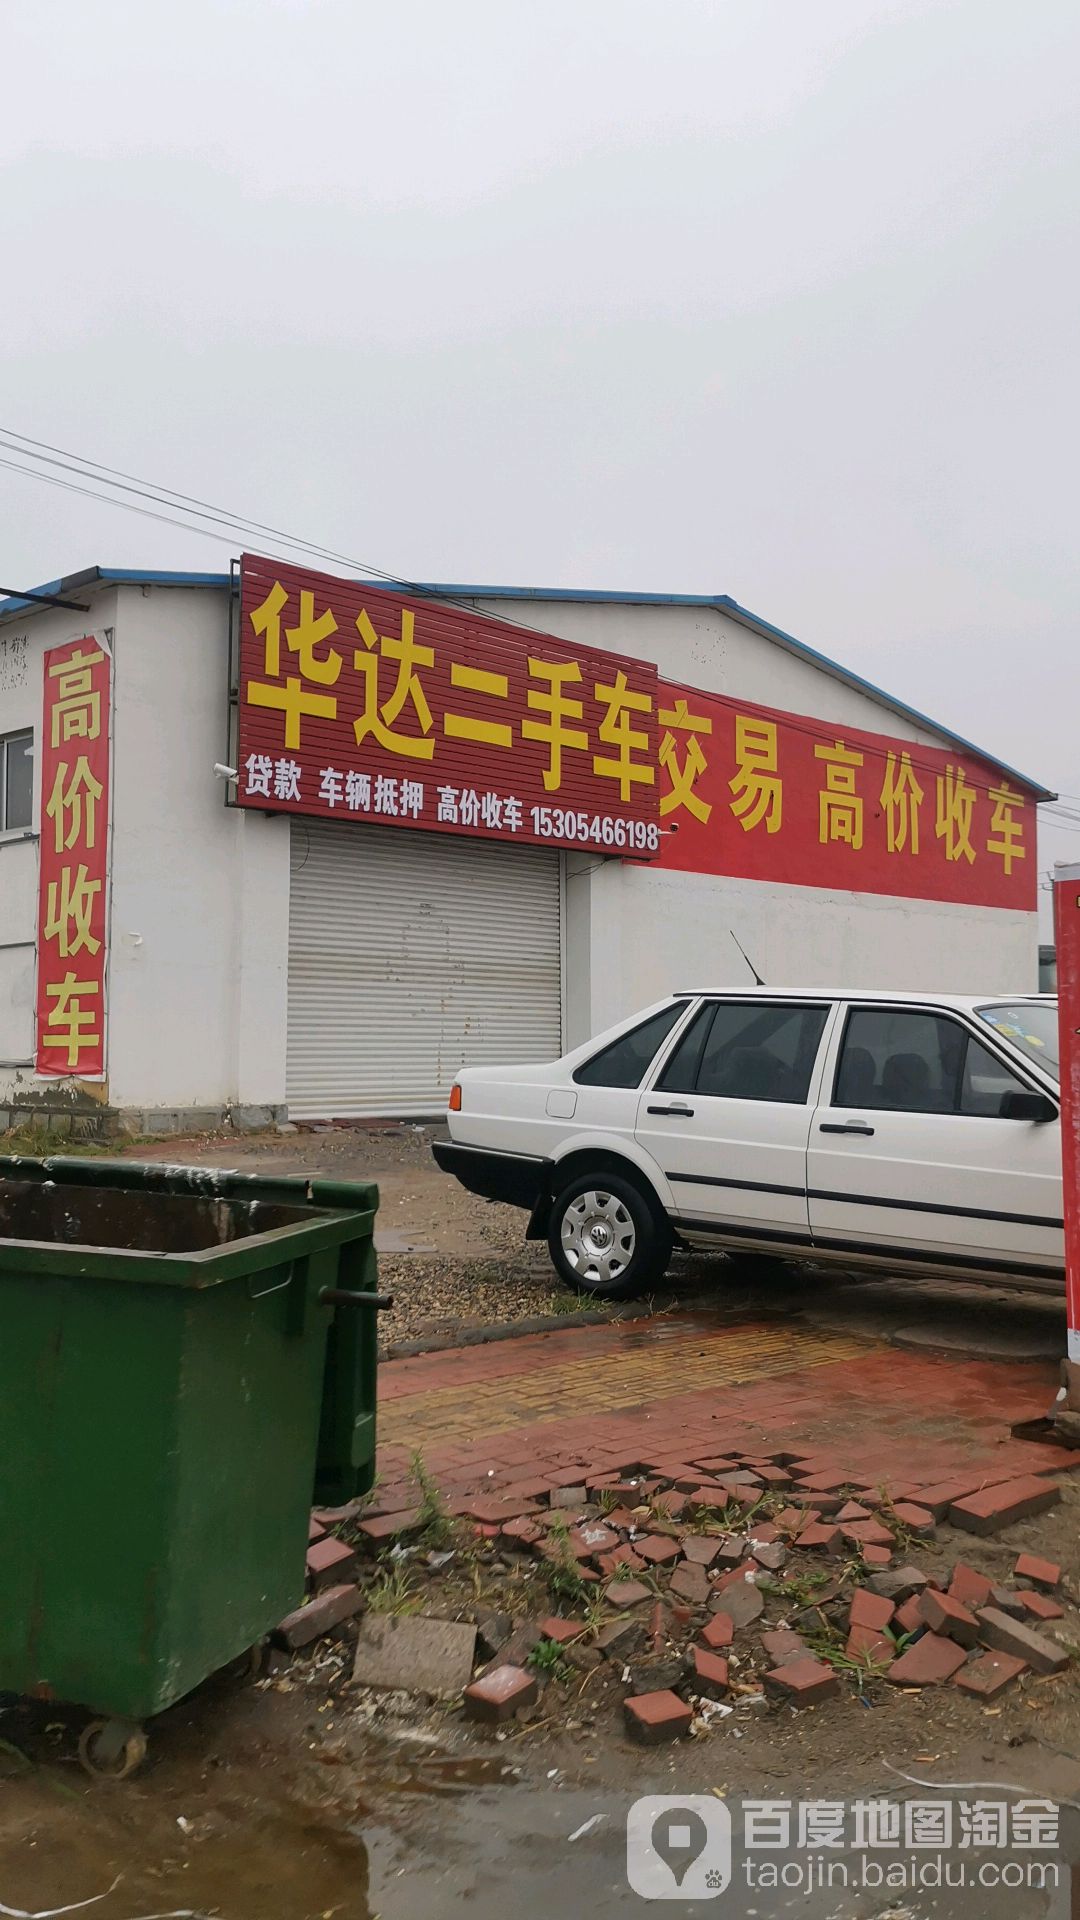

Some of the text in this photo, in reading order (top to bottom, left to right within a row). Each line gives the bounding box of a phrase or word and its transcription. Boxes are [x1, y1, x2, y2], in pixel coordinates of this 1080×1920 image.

[248, 580, 656, 802] 华达二手车
[658, 699, 1026, 875] 交易 高价收车
[42, 649, 104, 1068] 高价收车
[245, 753, 659, 850] 贷款 车辆抵押 高价收车 15305466198
